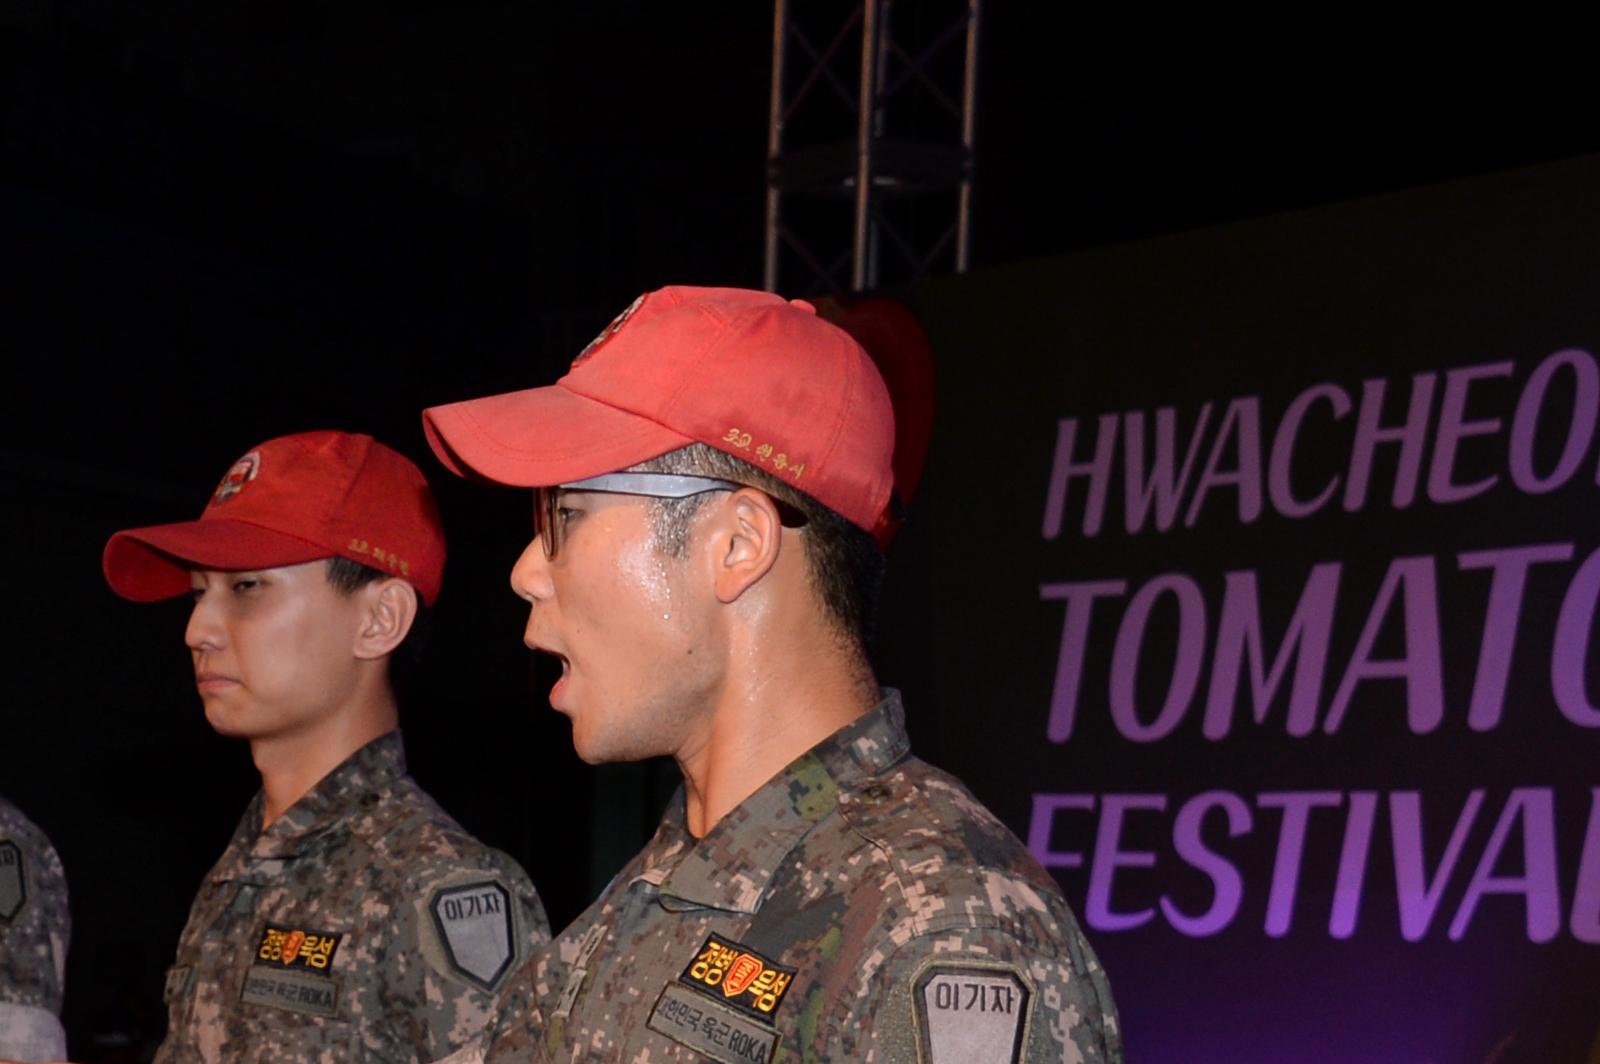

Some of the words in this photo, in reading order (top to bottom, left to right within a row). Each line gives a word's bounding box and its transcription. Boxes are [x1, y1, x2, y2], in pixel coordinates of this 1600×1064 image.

[1041, 348, 1600, 540] HWACHEO
[443, 892, 502, 922] 이기자
[747, 968, 792, 1013] 육성
[935, 982, 1015, 1015] 이기자
[702, 1017, 731, 1047] 육군
[728, 1029, 767, 1064] ROKA
